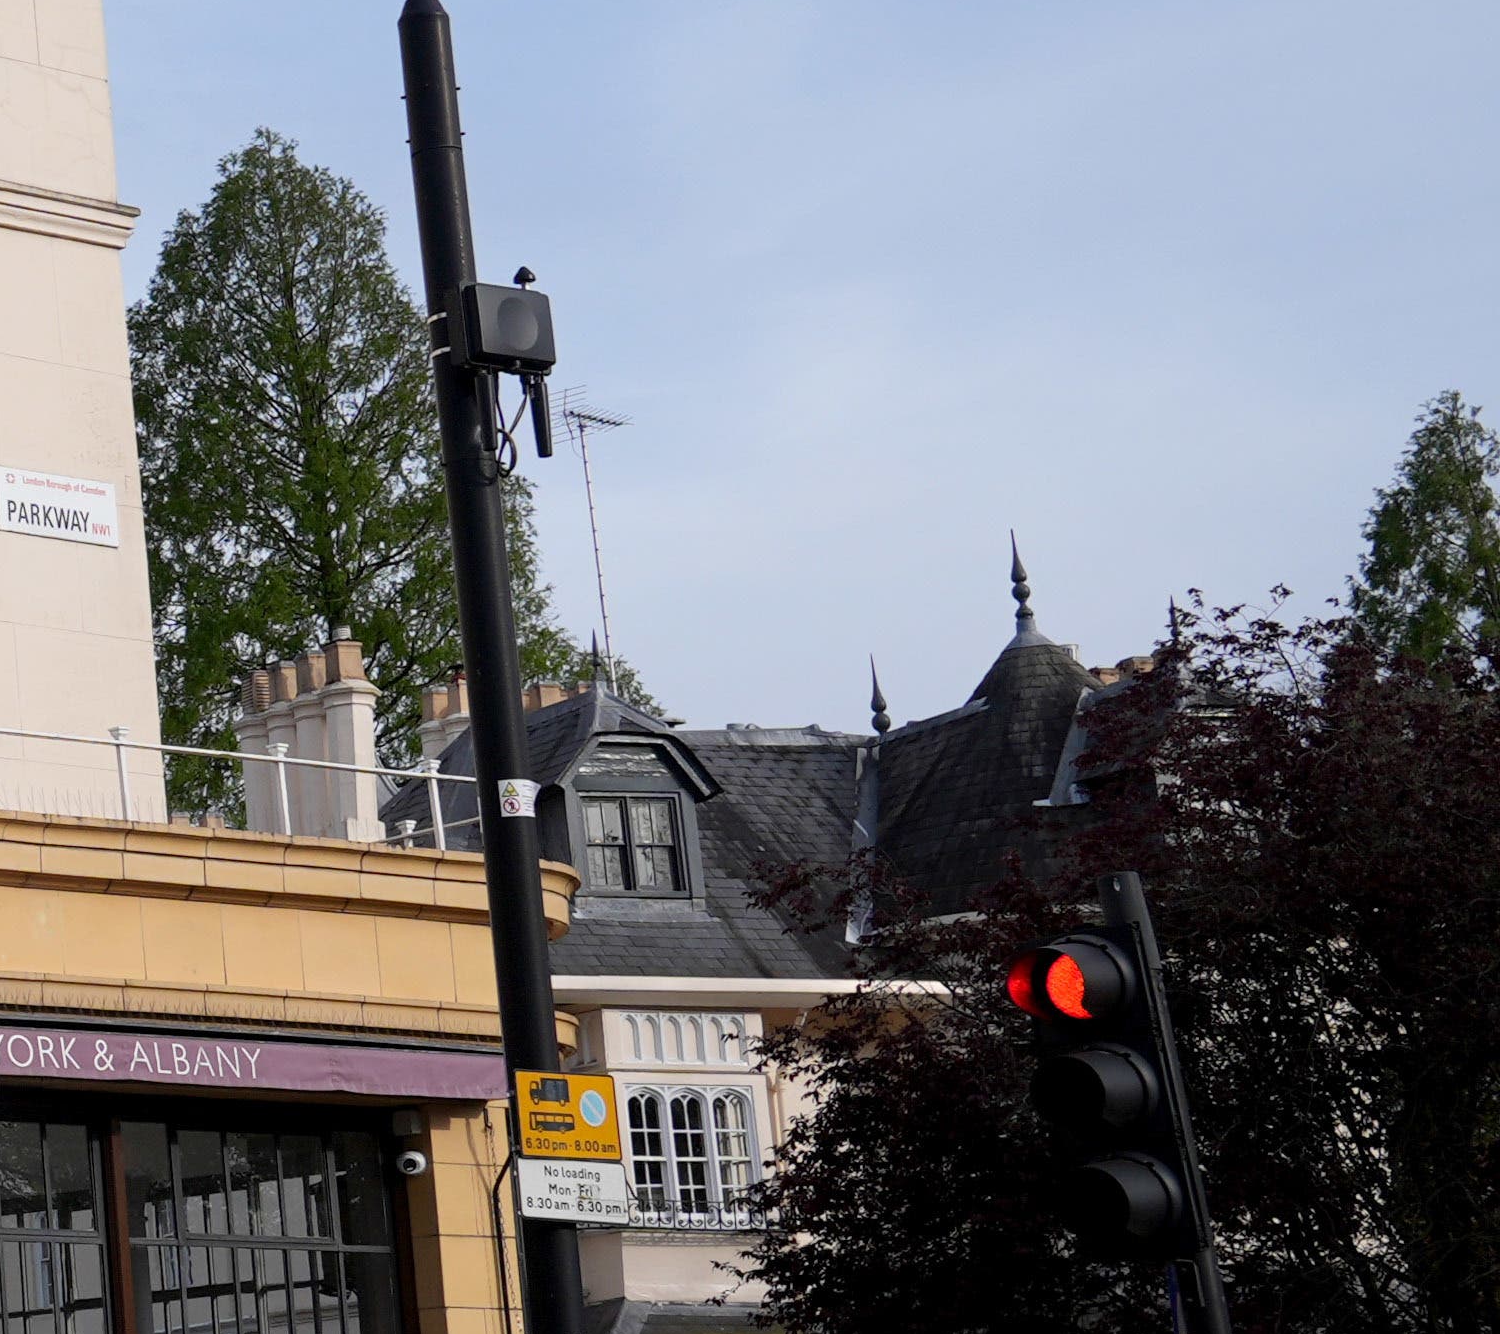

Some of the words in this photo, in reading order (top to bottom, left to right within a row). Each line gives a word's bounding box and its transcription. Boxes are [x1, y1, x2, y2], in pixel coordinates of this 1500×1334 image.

[7, 500, 89, 533] PARKWAY
[92, 523, 111, 537] NW1
[93, 1039, 116, 1072] &
[130, 1041, 262, 1080] ALBANY
[543, 1165, 559, 1178] No
[561, 1166, 601, 1183] loading
[577, 1201, 603, 1213] 6.30
